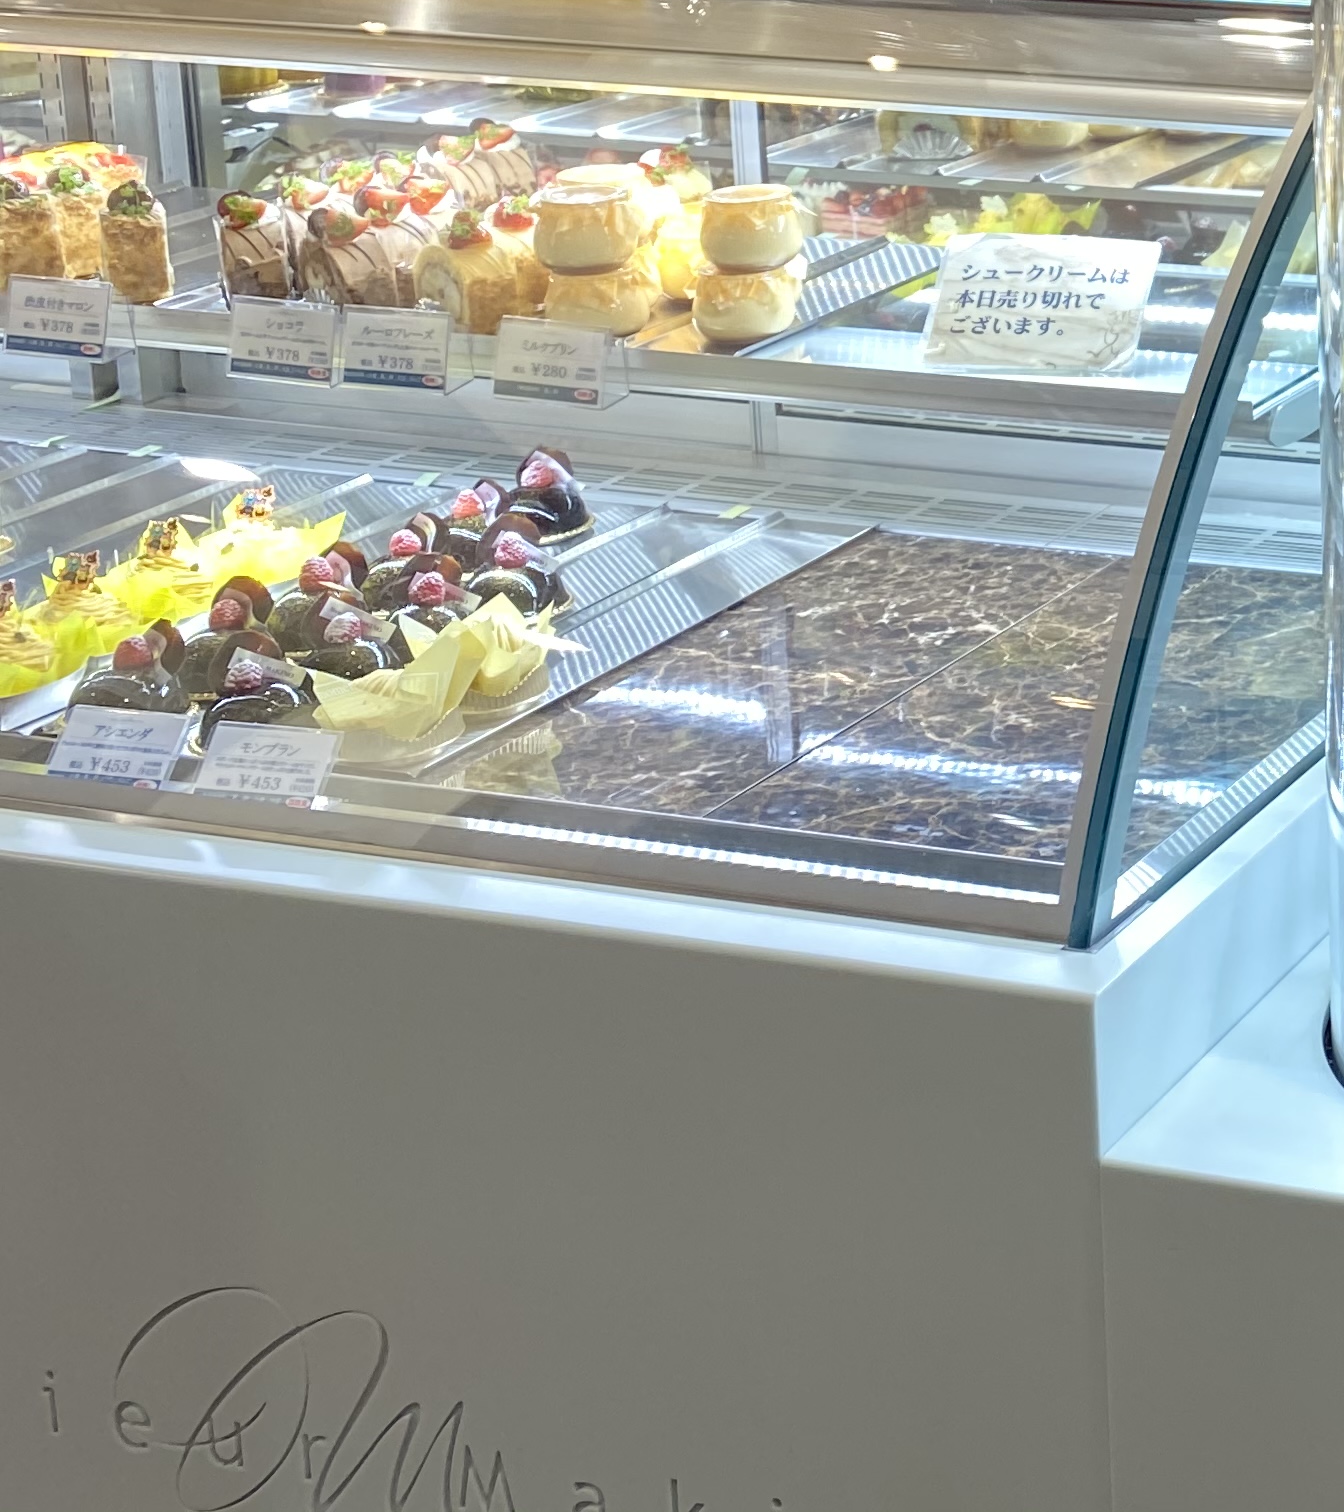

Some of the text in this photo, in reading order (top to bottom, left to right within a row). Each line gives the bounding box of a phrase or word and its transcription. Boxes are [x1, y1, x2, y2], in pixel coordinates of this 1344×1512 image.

[961, 264, 1130, 284] シュークリームは
[956, 289, 1106, 310] 本日売り切れで
[950, 317, 1065, 336] ございます。
[265, 346, 300, 362] ¥378
[378, 355, 414, 370] ¥378
[531, 363, 567, 378] ¥280
[93, 725, 154, 741] アシエンダ
[242, 742, 301, 756] モンブラン
[90, 757, 131, 773] ¥453
[239, 774, 282, 790] ¥453
